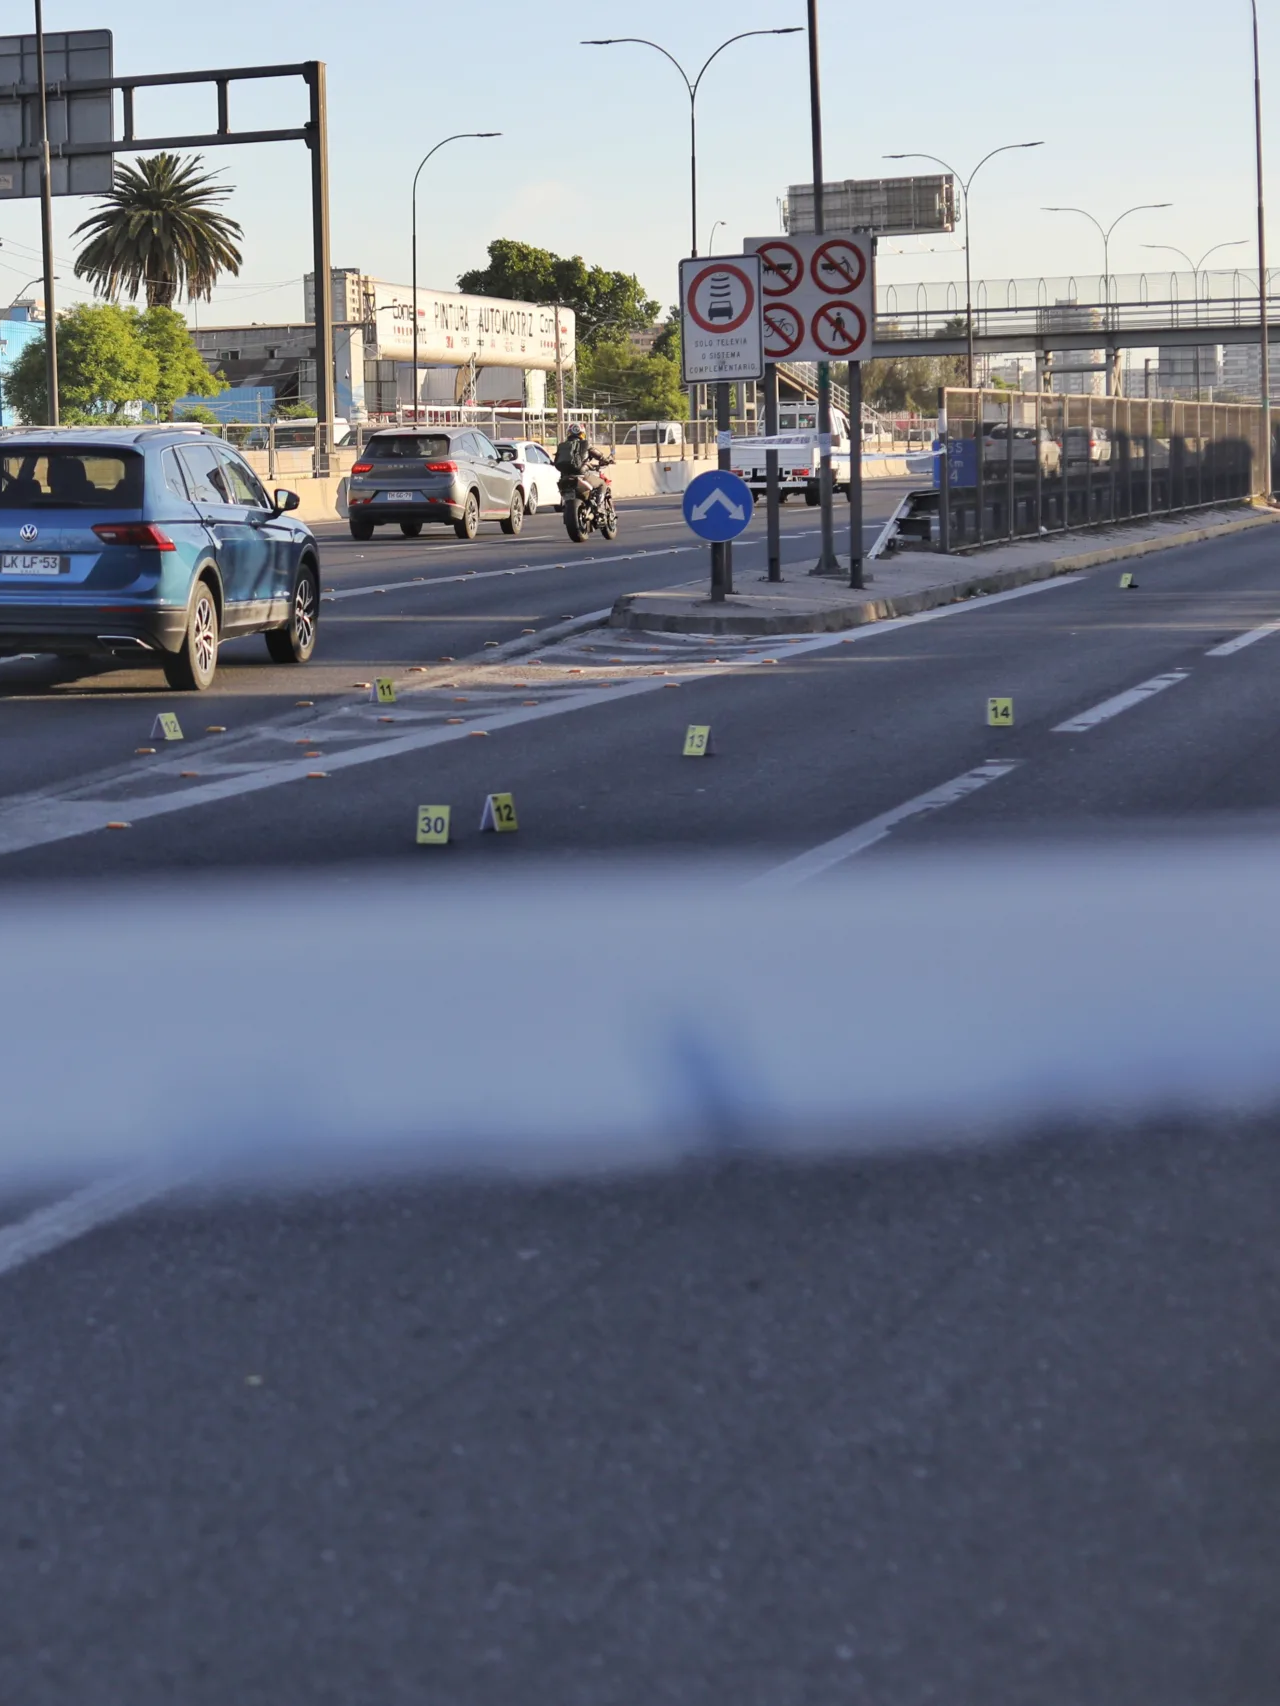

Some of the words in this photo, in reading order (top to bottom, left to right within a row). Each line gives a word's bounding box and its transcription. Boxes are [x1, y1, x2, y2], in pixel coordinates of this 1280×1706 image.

[434, 302, 469, 332] PINTURA
[477, 307, 533, 337] AUTOMOTRIZ
[695, 340, 713, 348] SOLO
[717, 338, 747, 346] TELEVIA
[709, 351, 740, 359] SISTEMA
[379, 684, 392, 696] 11
[991, 705, 1010, 719] 14
[689, 734, 705, 748] 13
[495, 803, 514, 822] 12
[420, 816, 445, 834] 30
